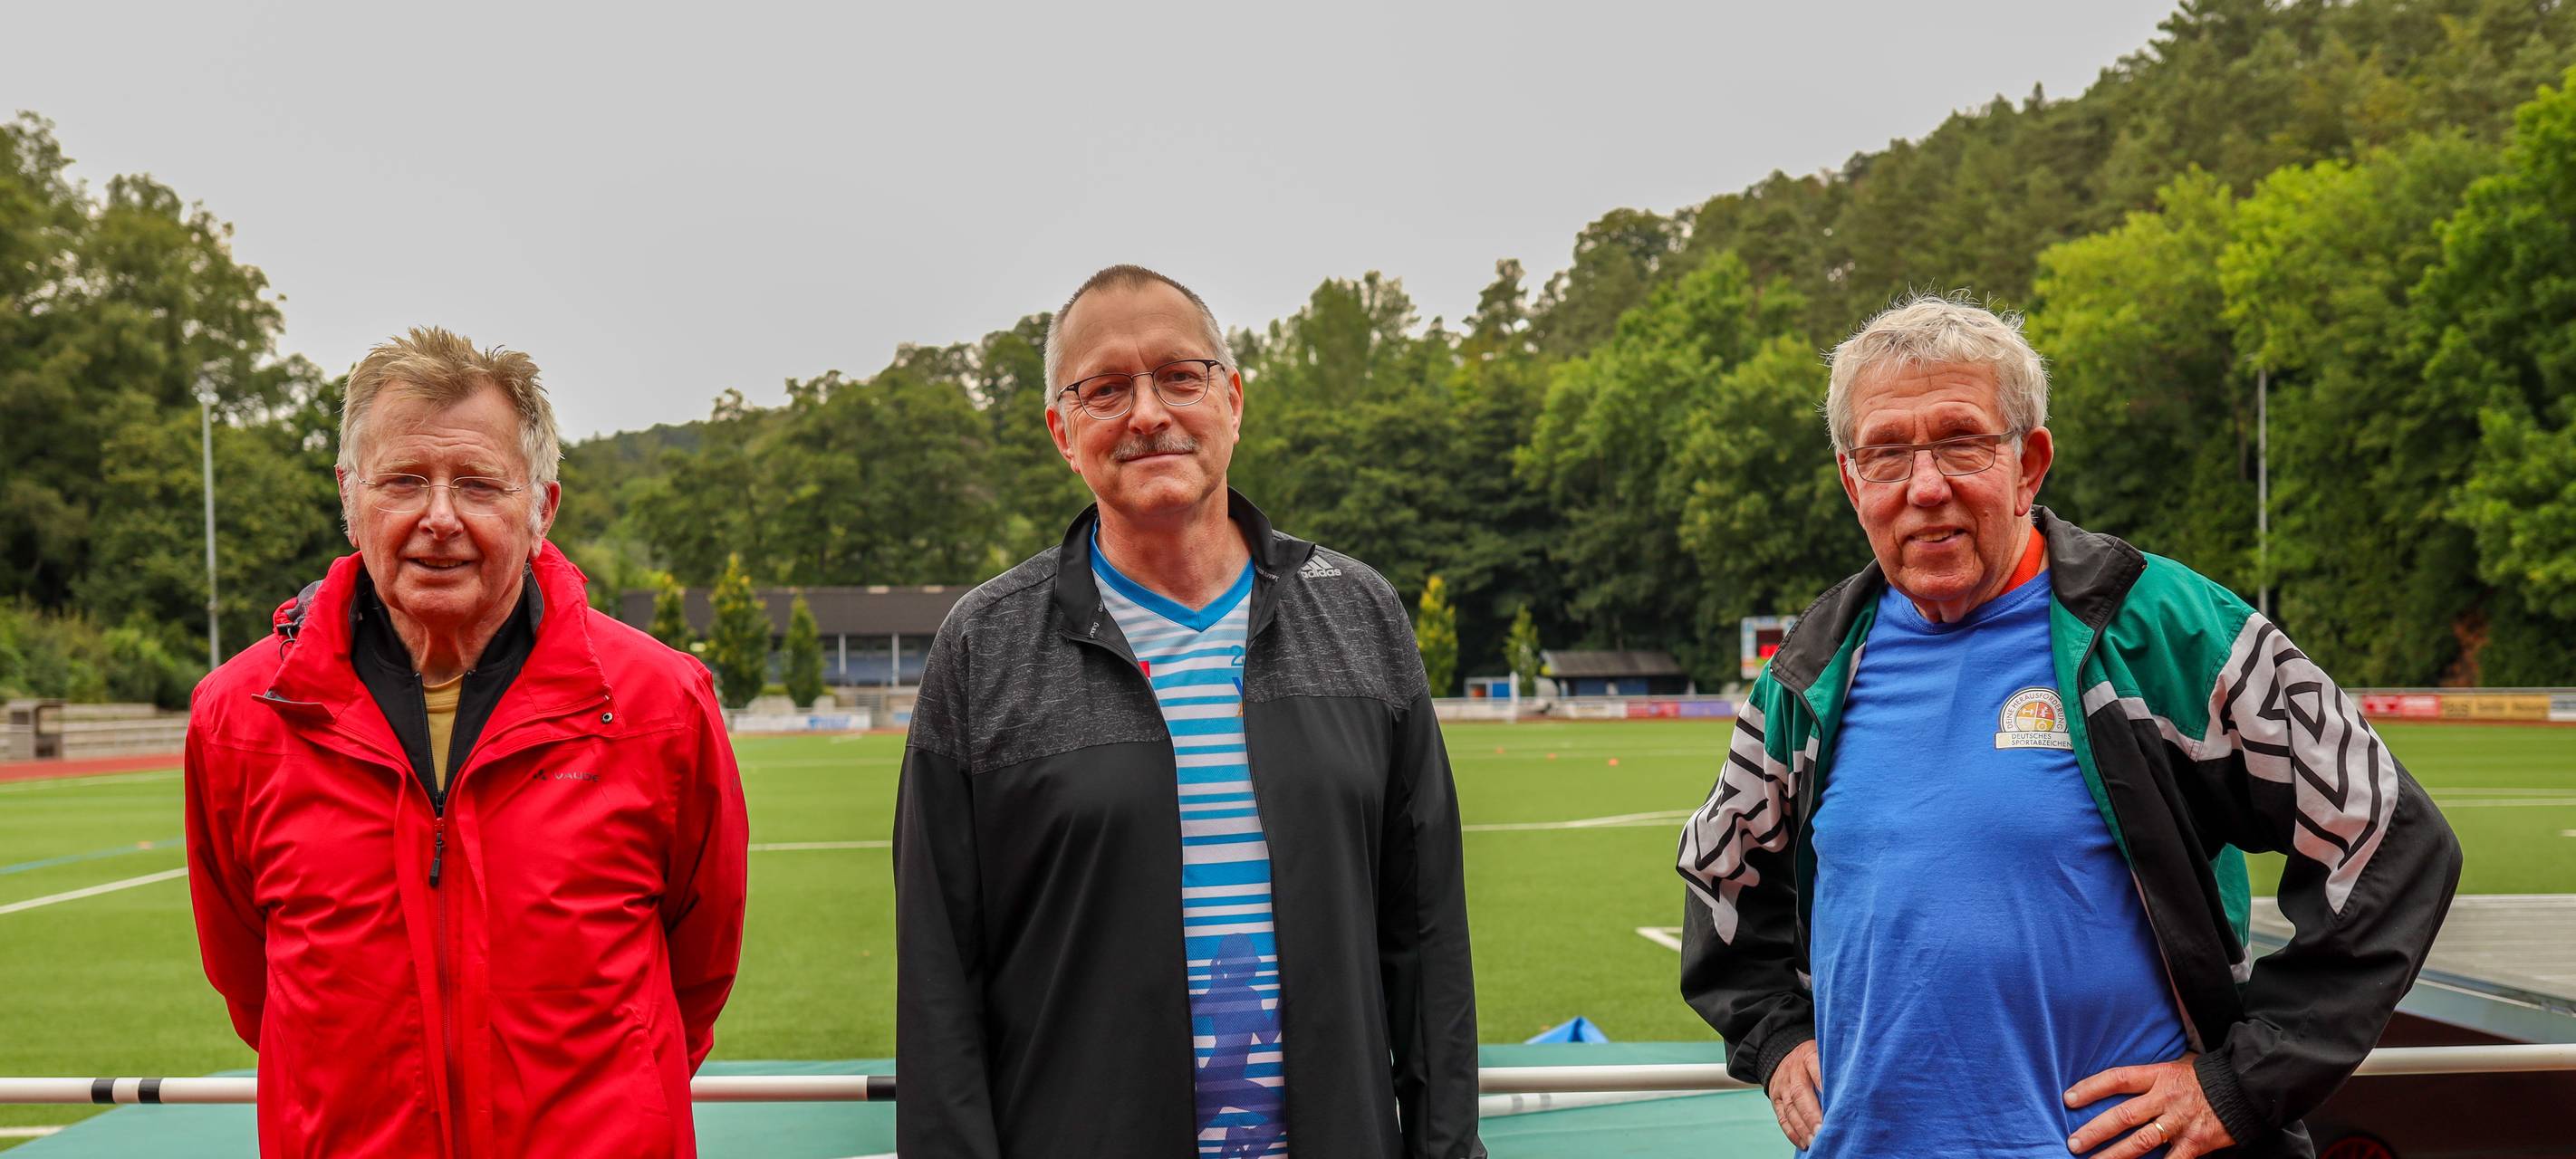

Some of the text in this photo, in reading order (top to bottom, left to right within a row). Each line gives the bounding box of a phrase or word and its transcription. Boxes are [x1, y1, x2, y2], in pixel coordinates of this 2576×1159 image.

[1300, 568, 1342, 579] adidas
[2006, 693, 2065, 731] DEINE HERAUSFORDERUNG
[2011, 739, 2072, 747] SPORTABZEICHEN
[554, 771, 601, 782] VAUDE
